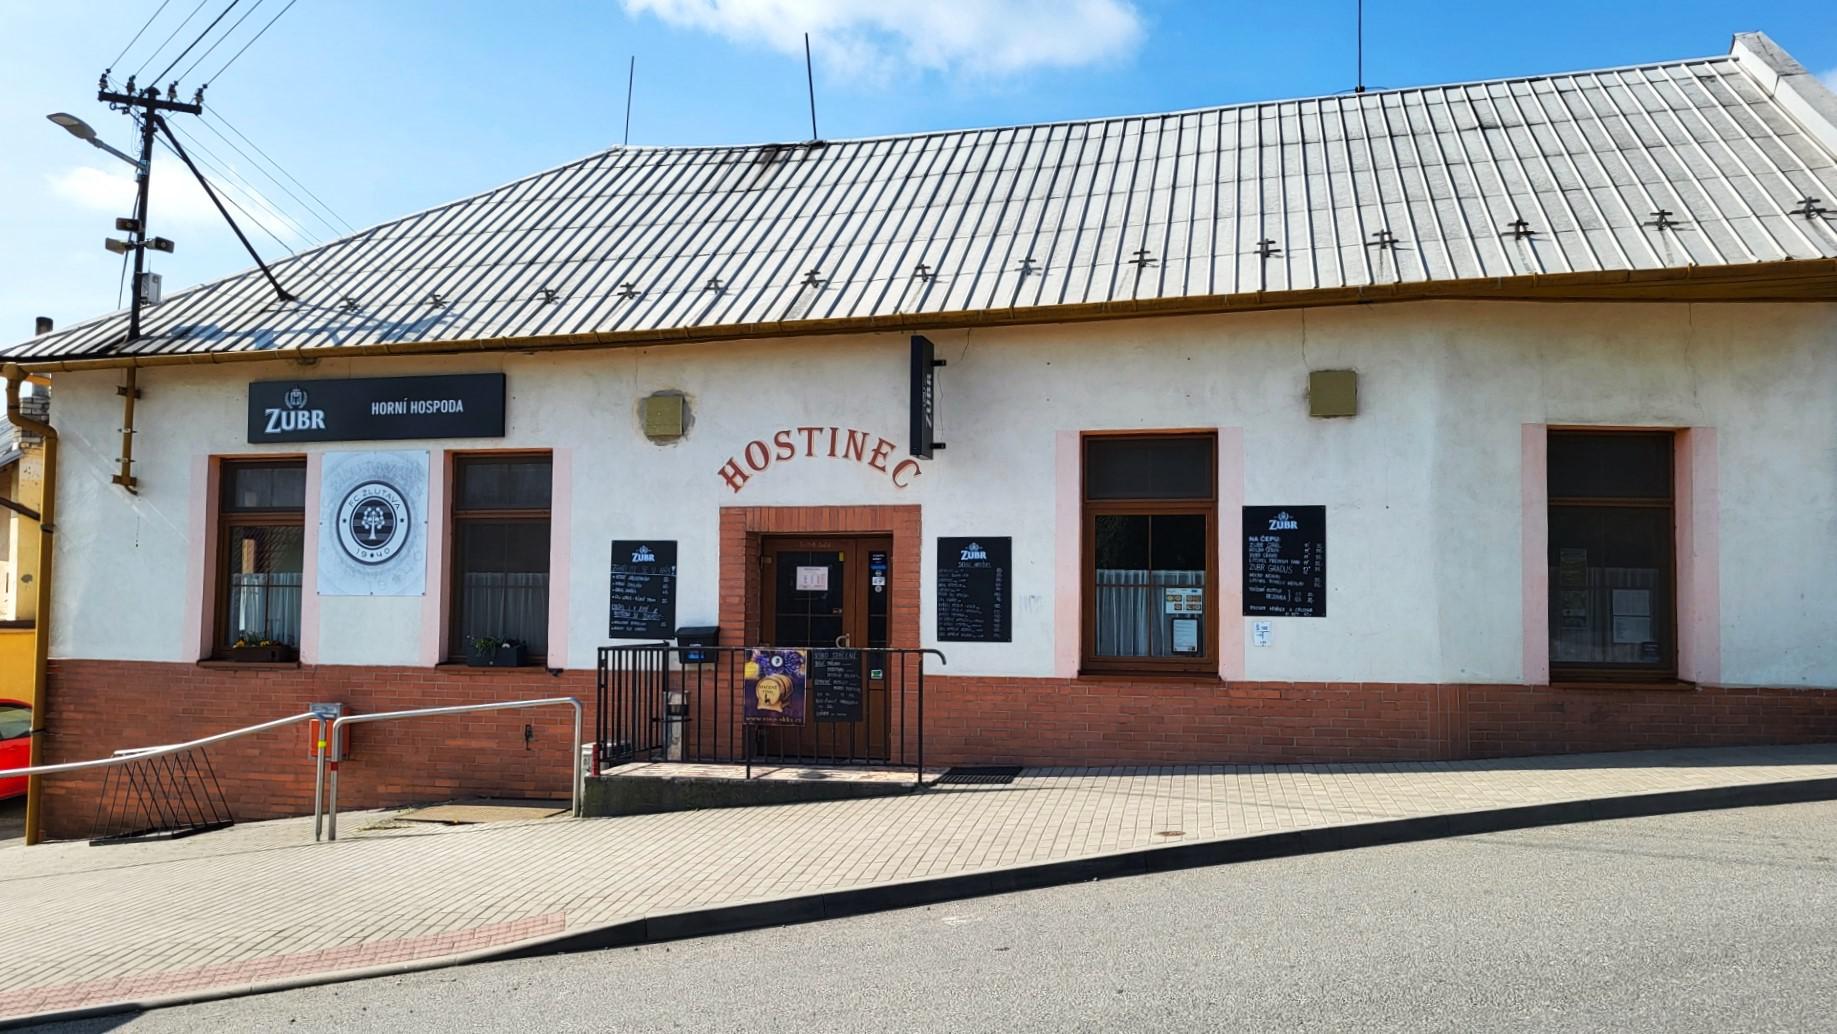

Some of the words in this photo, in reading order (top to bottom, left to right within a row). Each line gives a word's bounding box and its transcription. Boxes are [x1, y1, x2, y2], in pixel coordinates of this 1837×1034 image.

[371, 398, 408, 415] HORNÍ
[410, 399, 464, 414] HOSPODA
[264, 408, 326, 434] ZUBR
[717, 427, 922, 494] HOSTINEC
[1268, 519, 1298, 530] ZUBR
[631, 552, 656, 562] ZUBR
[960, 550, 987, 560] ZUBR
